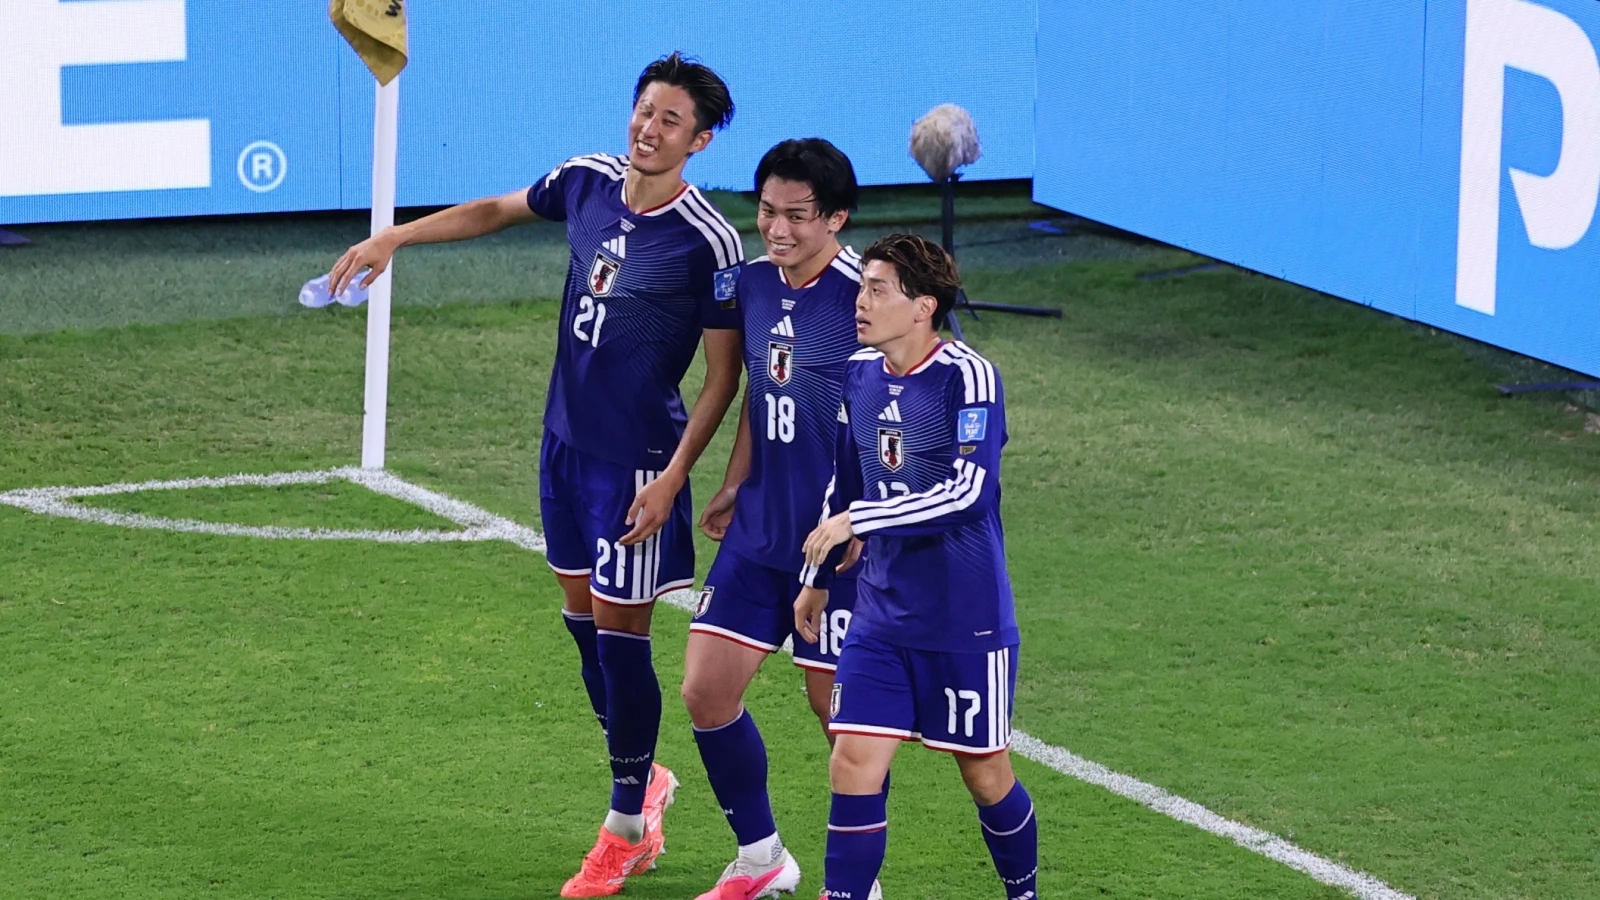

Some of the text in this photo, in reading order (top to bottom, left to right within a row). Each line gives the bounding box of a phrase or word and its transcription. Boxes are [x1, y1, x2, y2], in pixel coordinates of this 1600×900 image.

[1455, 0, 1600, 316] P
[573, 295, 607, 348] 21
[764, 392, 796, 444] 18
[595, 537, 627, 589] 21
[819, 608, 853, 657] 18
[943, 686, 982, 738] 17
